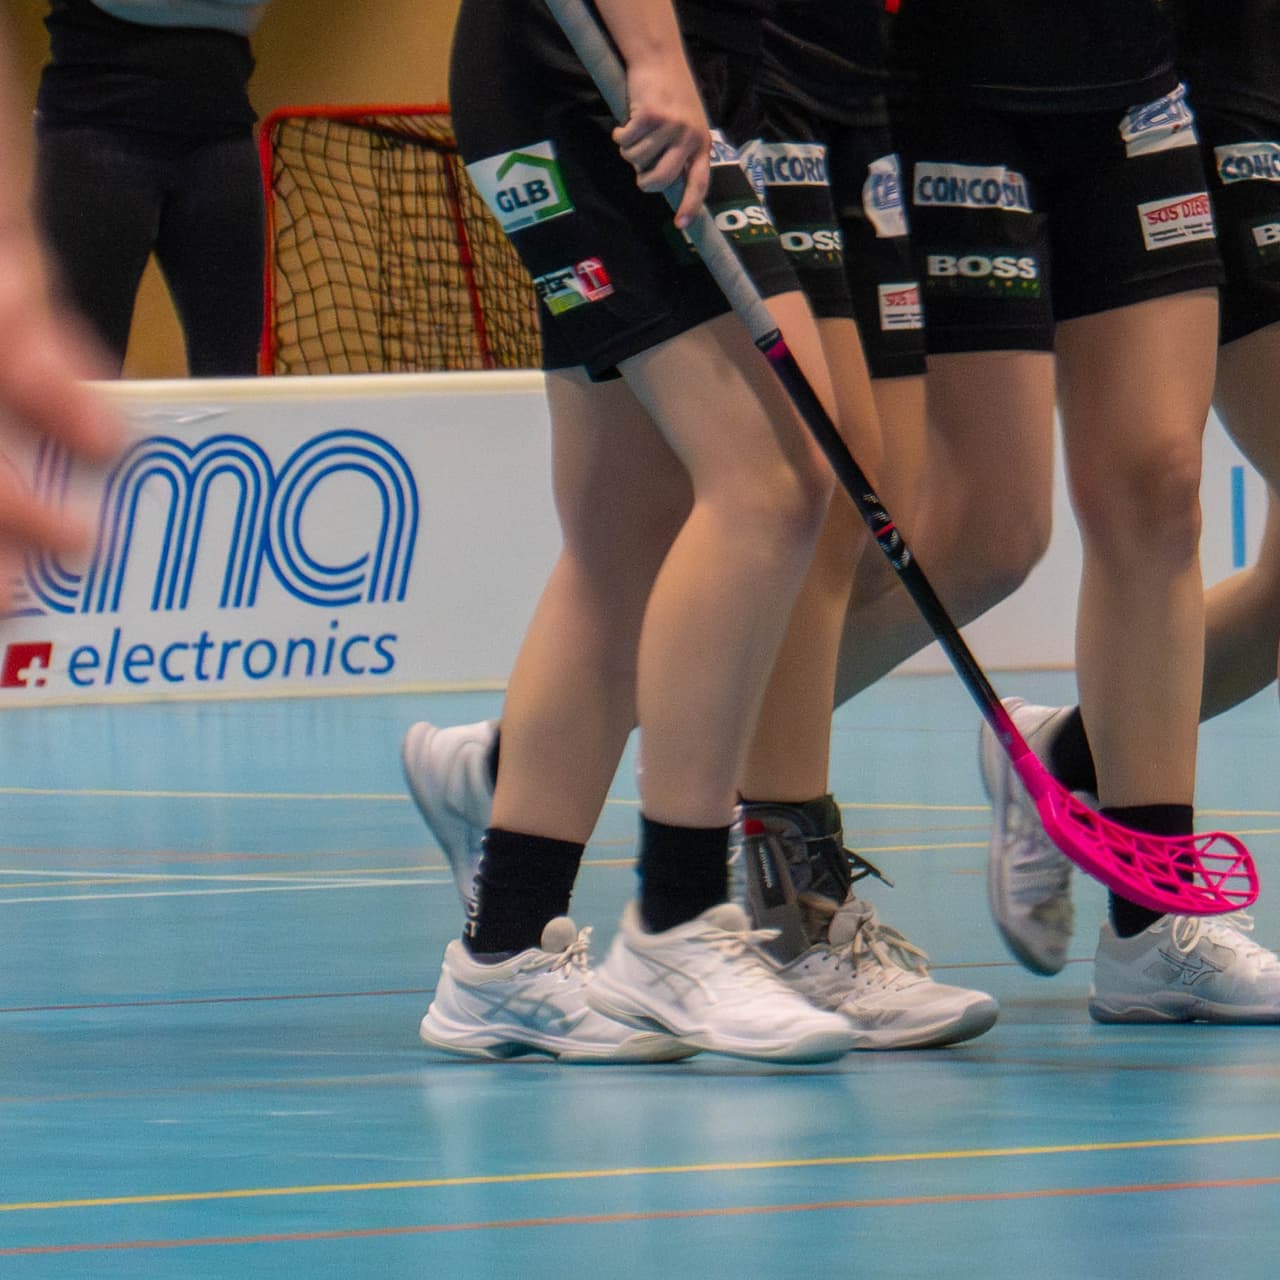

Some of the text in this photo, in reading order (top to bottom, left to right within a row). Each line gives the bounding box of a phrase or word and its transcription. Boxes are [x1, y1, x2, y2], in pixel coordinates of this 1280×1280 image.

[495, 178, 550, 214] GLB
[714, 205, 772, 232] OS
[778, 229, 841, 252] OS
[926, 254, 1039, 280] BOSS
[68, 620, 399, 687] electronics
